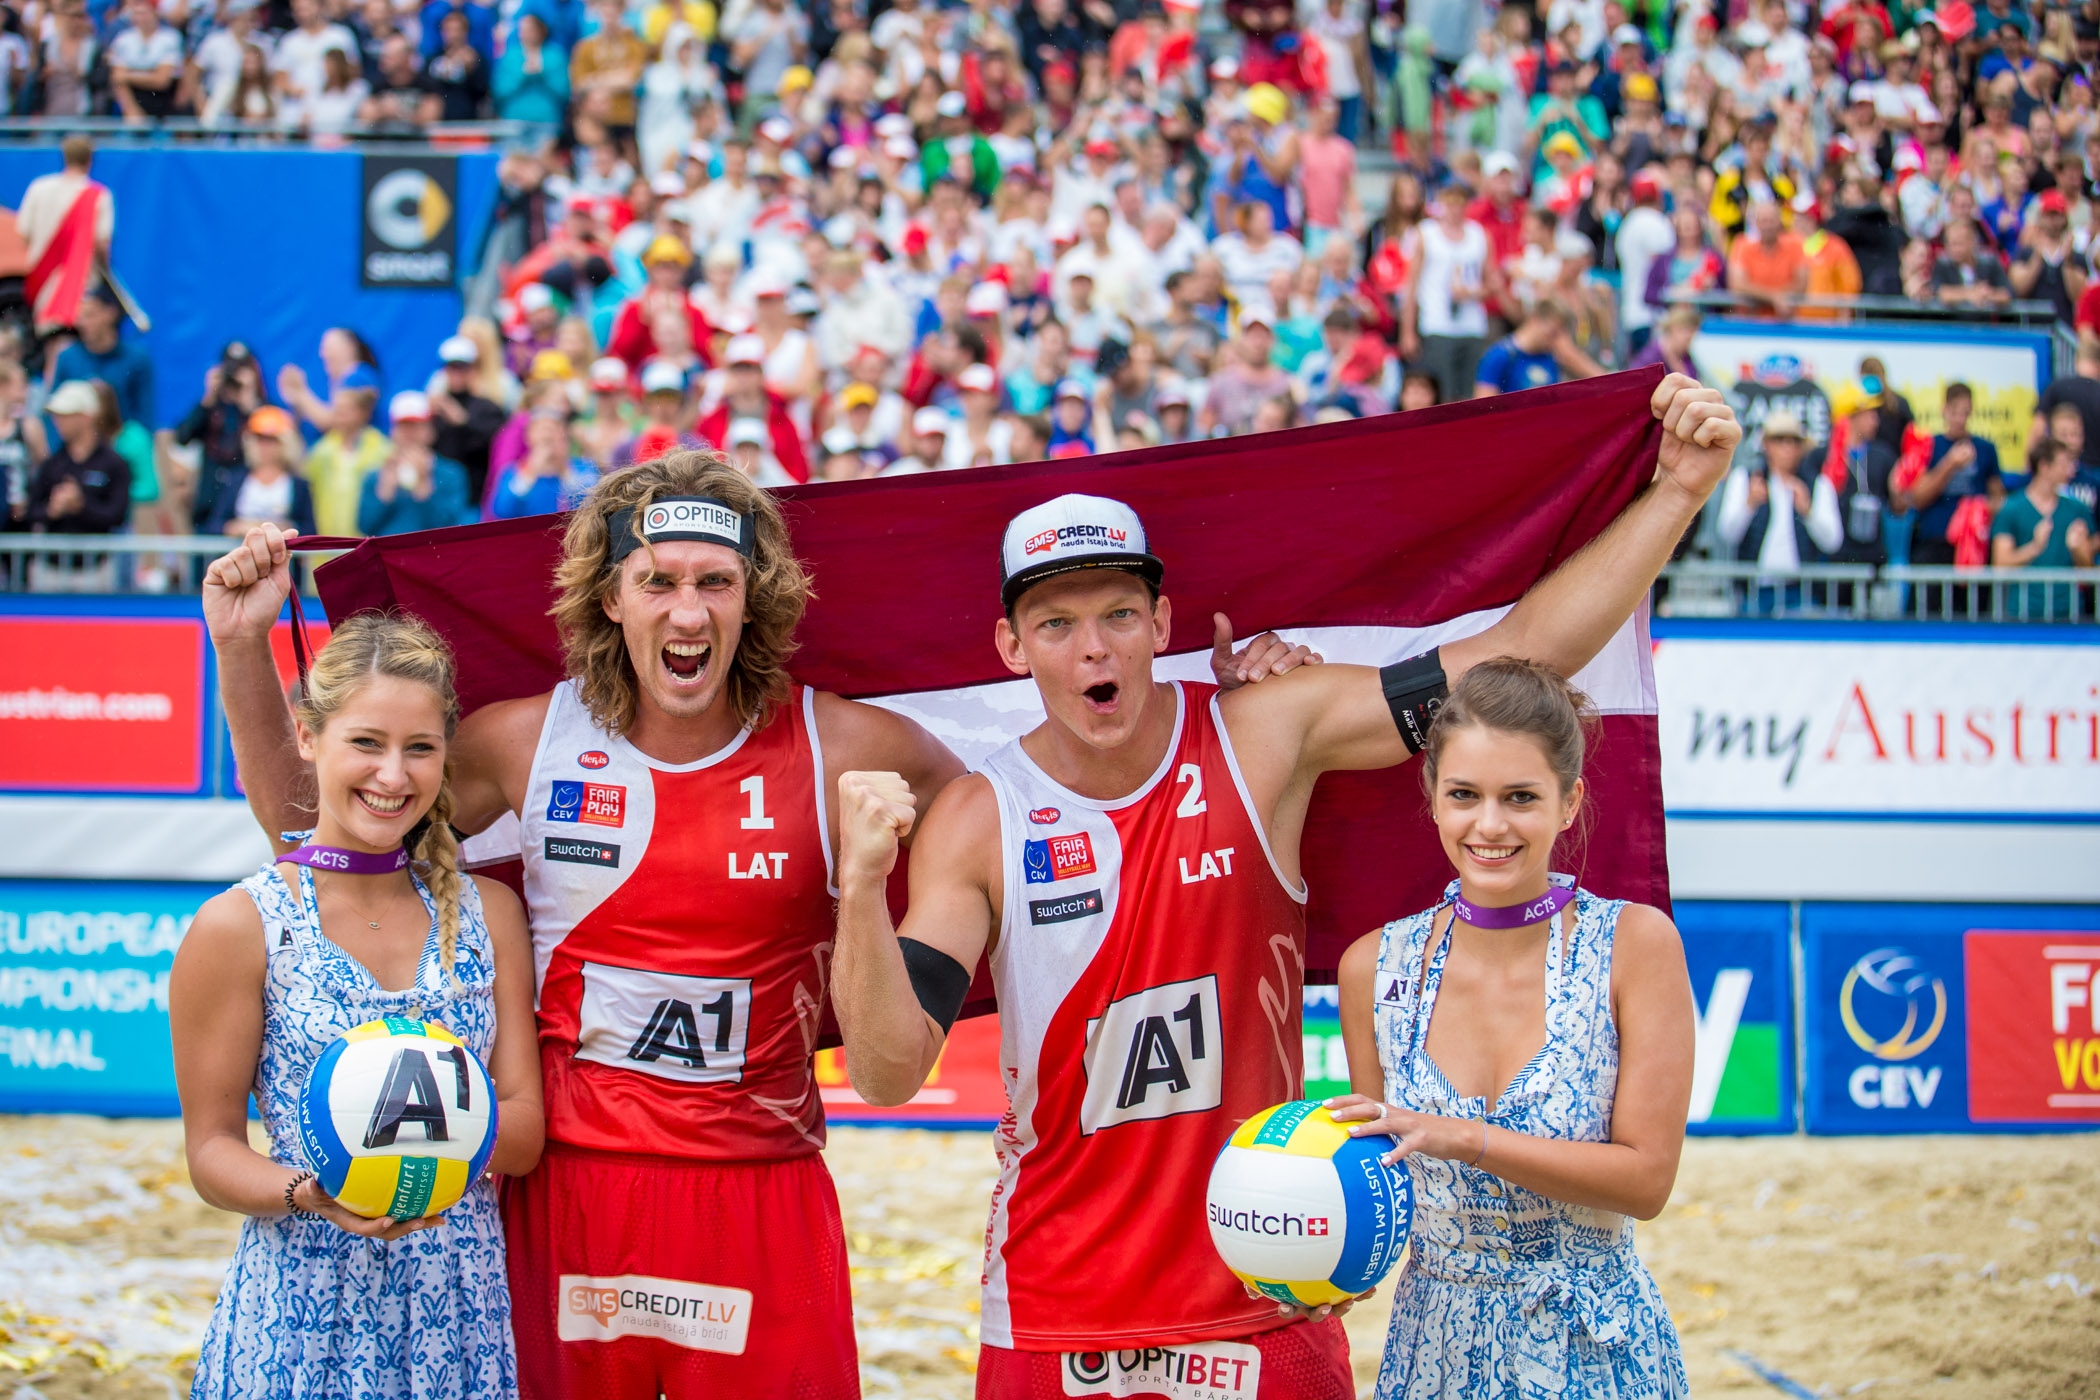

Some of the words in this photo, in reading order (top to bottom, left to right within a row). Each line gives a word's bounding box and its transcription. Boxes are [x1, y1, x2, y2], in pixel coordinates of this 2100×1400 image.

[674, 505, 737, 530] OPTIBET
[1060, 538, 1085, 548] nauda
[589, 788, 619, 803] FAIR
[740, 776, 774, 829] 1
[1176, 763, 1207, 818] 2
[552, 809, 574, 819] CEV
[587, 801, 619, 816] PLAY
[309, 850, 349, 869] ACTS
[550, 844, 600, 858] swatch
[1053, 839, 1085, 855] FAIR
[1057, 850, 1087, 868] PLAY
[728, 852, 788, 879] LAT
[1178, 847, 1235, 885] LAT
[1037, 899, 1087, 917] swatch
[1524, 896, 1556, 921] ACTS
[1384, 979, 1408, 1001] A1
[627, 991, 733, 1068] A1
[1116, 993, 1205, 1109] A1
[362, 1045, 470, 1149] A1
[1848, 1064, 1943, 1109] CEV
[301, 1100, 312, 1124] AM
[305, 1129, 330, 1166] LUST
[1360, 1158, 1383, 1198] LUST
[1209, 1203, 1303, 1236] swatch
[1374, 1202, 1386, 1229] AM
[1361, 1232, 1385, 1281] LEBEN
[571, 1289, 736, 1324] SMSCREDIT.LV
[622, 1315, 660, 1328] nauda
[663, 1320, 697, 1339] īstajā
[701, 1326, 729, 1341] brīdī
[1117, 1348, 1250, 1391] OPTIBET
[1120, 1375, 1179, 1394] SPORTA
